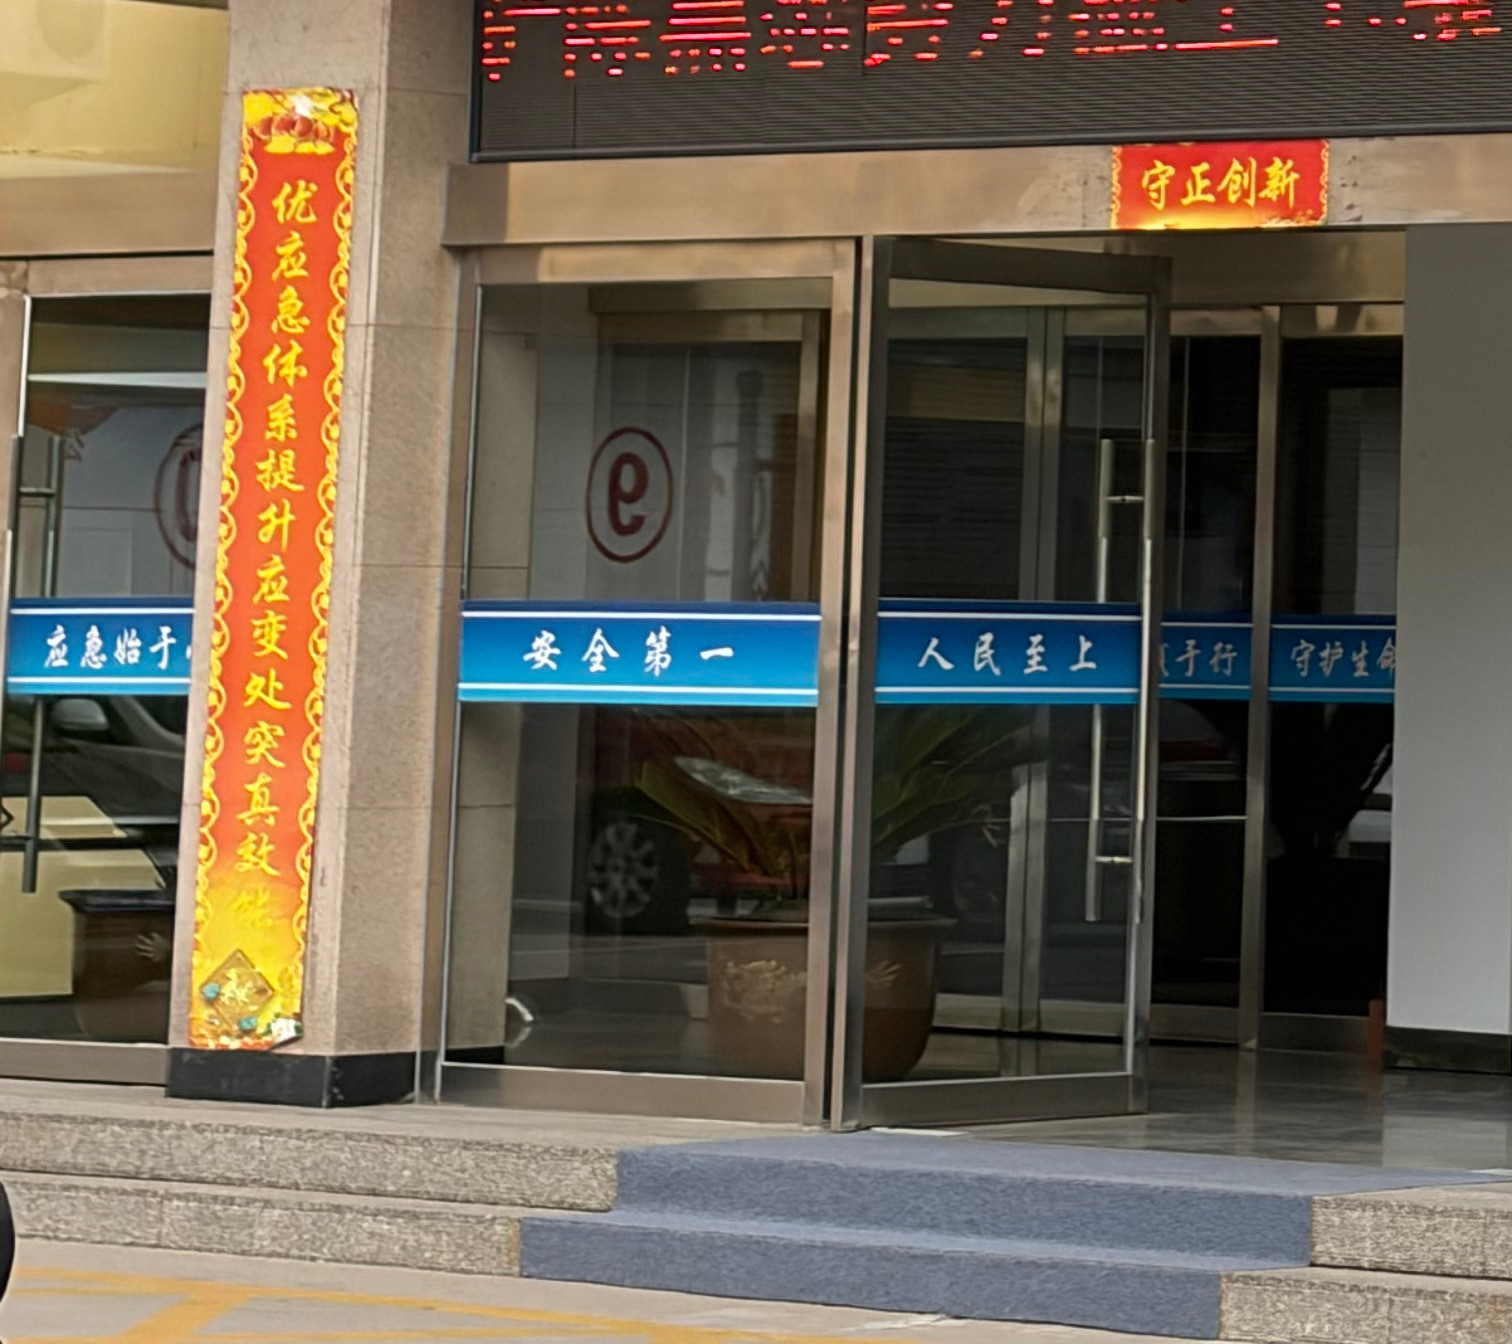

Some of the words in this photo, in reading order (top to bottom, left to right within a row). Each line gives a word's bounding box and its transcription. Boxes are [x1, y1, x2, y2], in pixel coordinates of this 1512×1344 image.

[1141, 156, 1300, 212] 守正创新
[232, 179, 318, 929] 优应急体系提升应变处突真效能
[45, 624, 192, 670] 应急始于
[522, 626, 734, 676] 安全第一
[917, 631, 1098, 676] 人民至上
[1160, 638, 1238, 678] 于行
